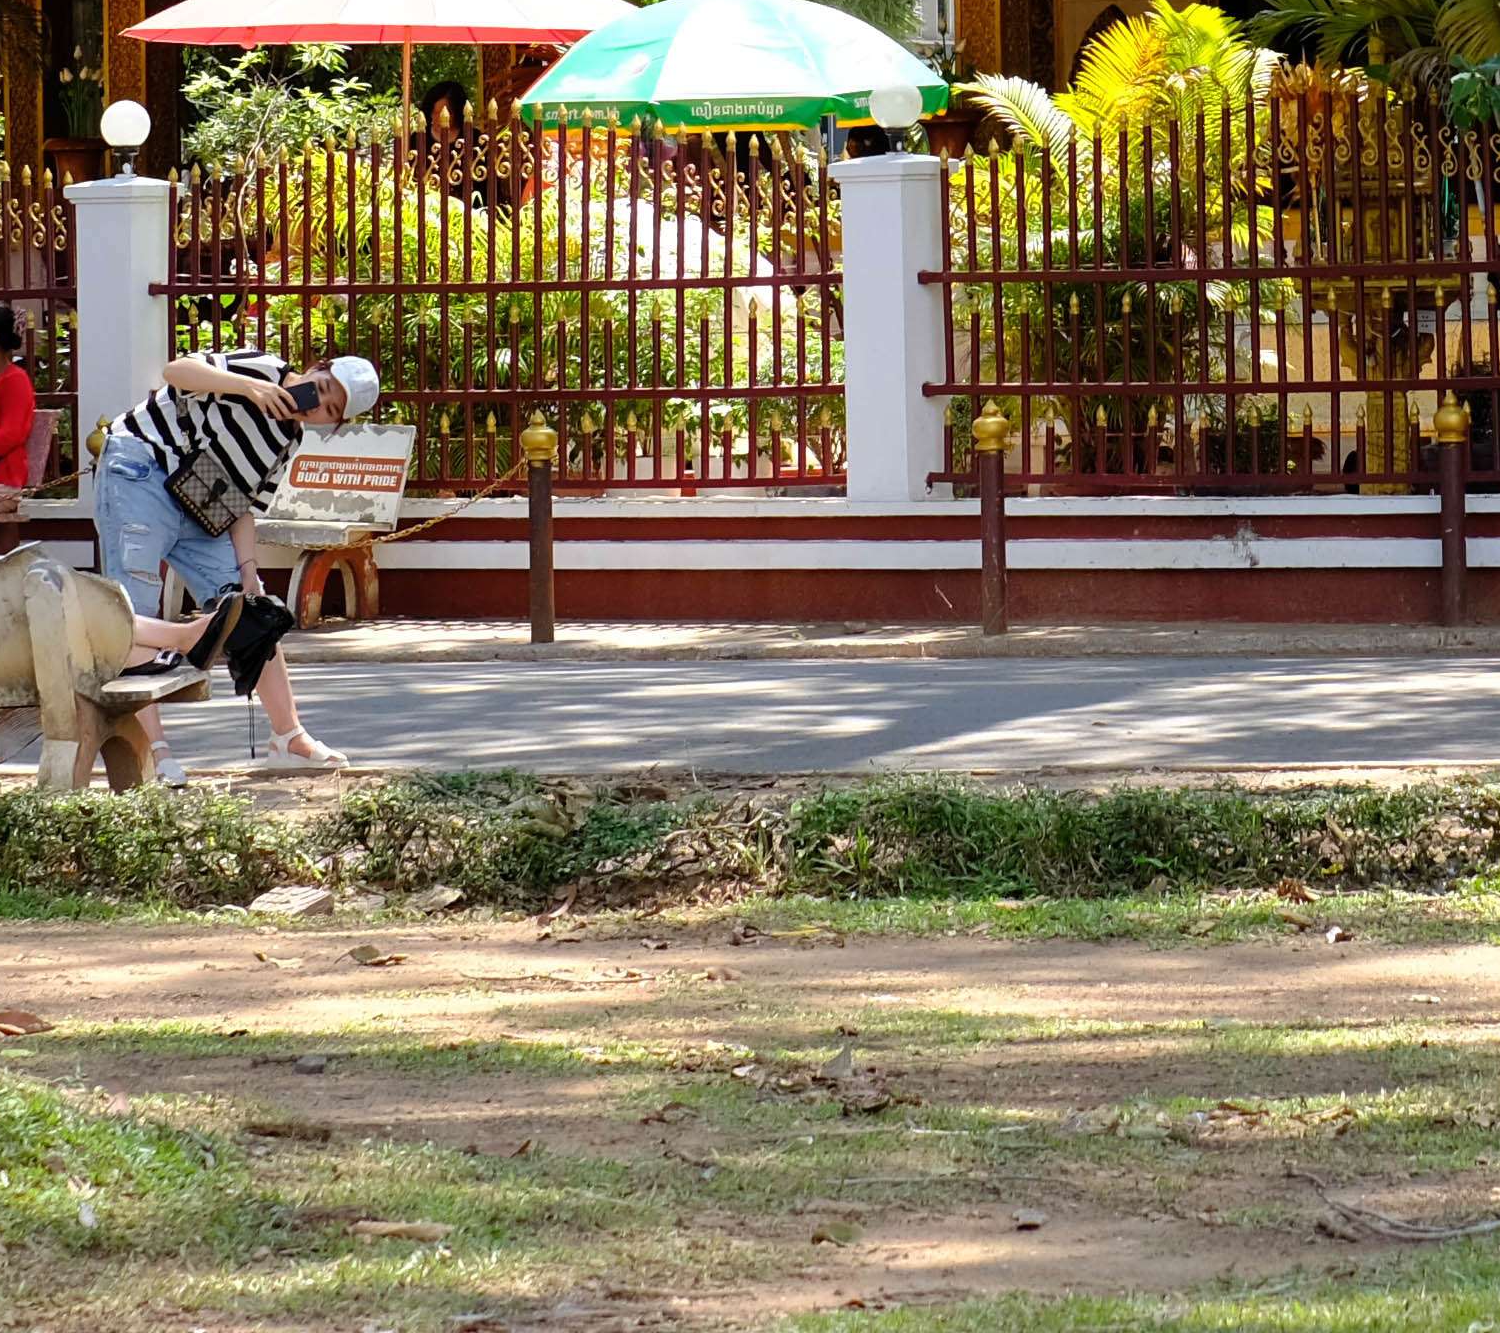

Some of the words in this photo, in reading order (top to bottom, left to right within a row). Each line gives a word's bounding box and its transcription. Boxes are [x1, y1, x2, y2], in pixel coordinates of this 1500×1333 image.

[545, 106, 620, 121] smrt.m.kh
[296, 471, 329, 484] BUILD
[332, 473, 361, 486] WITH
[363, 474, 398, 487] PRIDE
